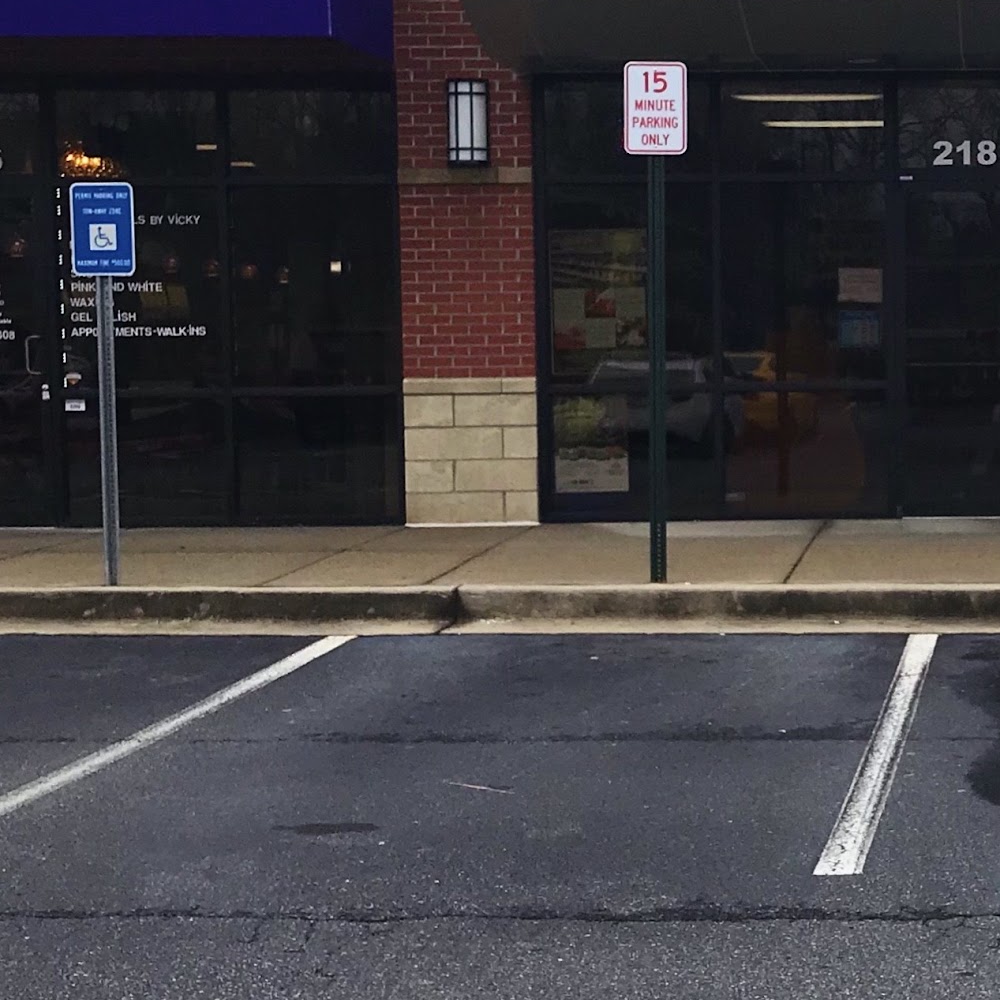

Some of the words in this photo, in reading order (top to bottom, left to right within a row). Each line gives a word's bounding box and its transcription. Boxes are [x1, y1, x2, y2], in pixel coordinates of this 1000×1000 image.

[643, 70, 668, 93] 15
[635, 100, 676, 111] MINUTE
[632, 117, 678, 128] PARKING
[641, 134, 670, 146] ONLY
[933, 140, 997, 166] 218
[149, 215, 163, 226] BY
[71, 312, 93, 322] GEL
